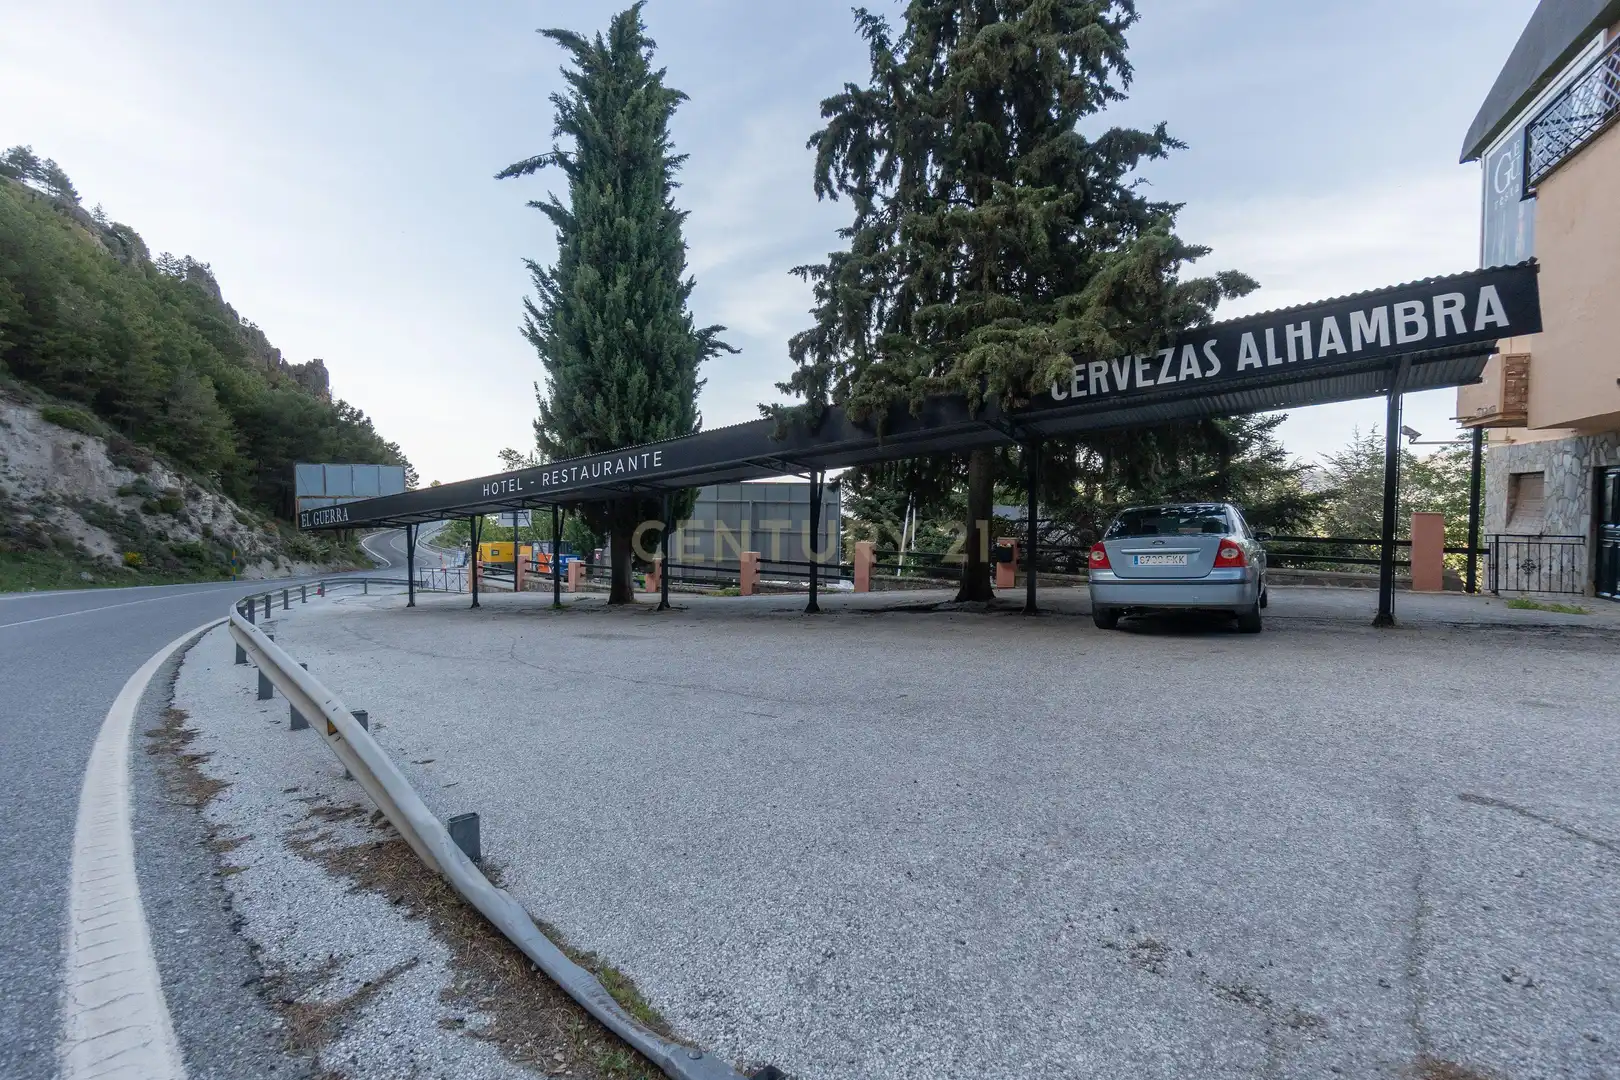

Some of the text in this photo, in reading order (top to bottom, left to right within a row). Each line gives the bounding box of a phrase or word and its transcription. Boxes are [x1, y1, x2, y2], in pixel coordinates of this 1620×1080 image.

[1236, 284, 1511, 372] ALHAMBRA
[482, 478, 523, 497] HOTEL
[542, 450, 663, 487] RESTAURANTE
[301, 507, 349, 528] EL GUERRA
